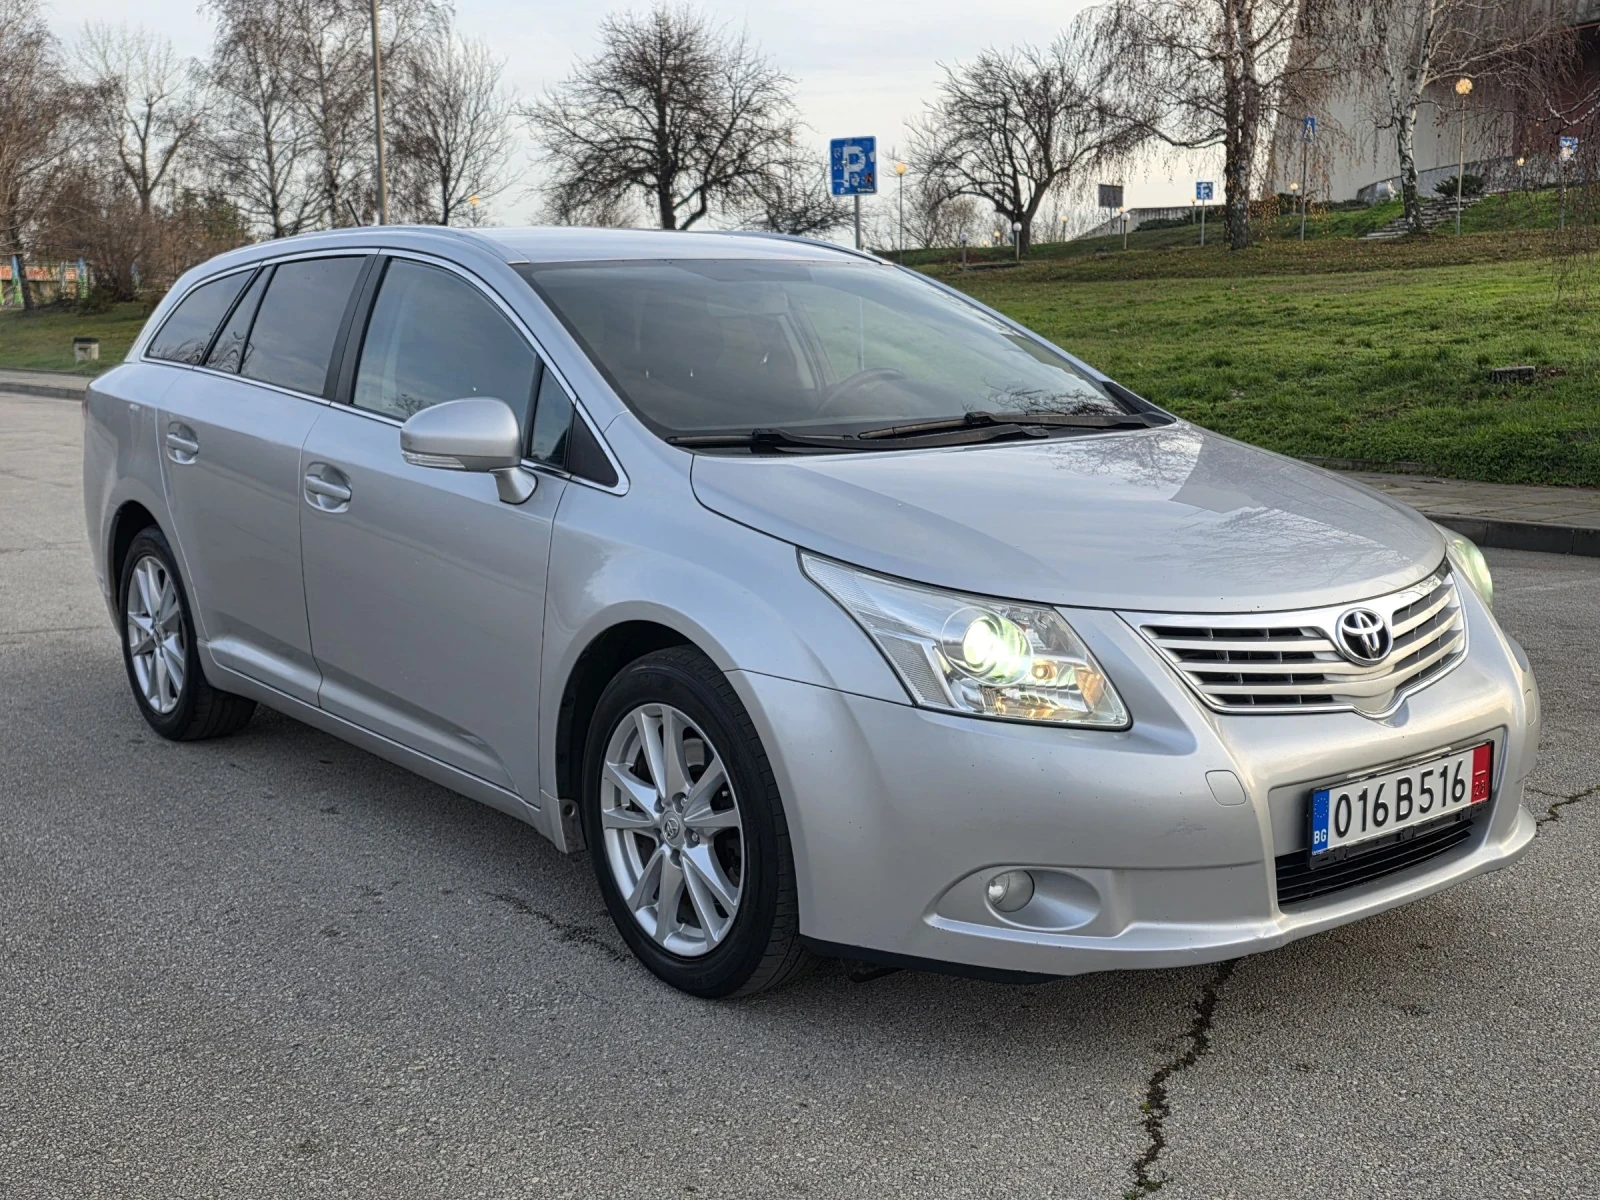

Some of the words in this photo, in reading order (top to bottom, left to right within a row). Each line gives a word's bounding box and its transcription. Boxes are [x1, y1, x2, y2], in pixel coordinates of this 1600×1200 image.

[843, 146, 866, 188] P
[1334, 759, 1466, 838] 016B516
[1313, 828, 1327, 845] BG
